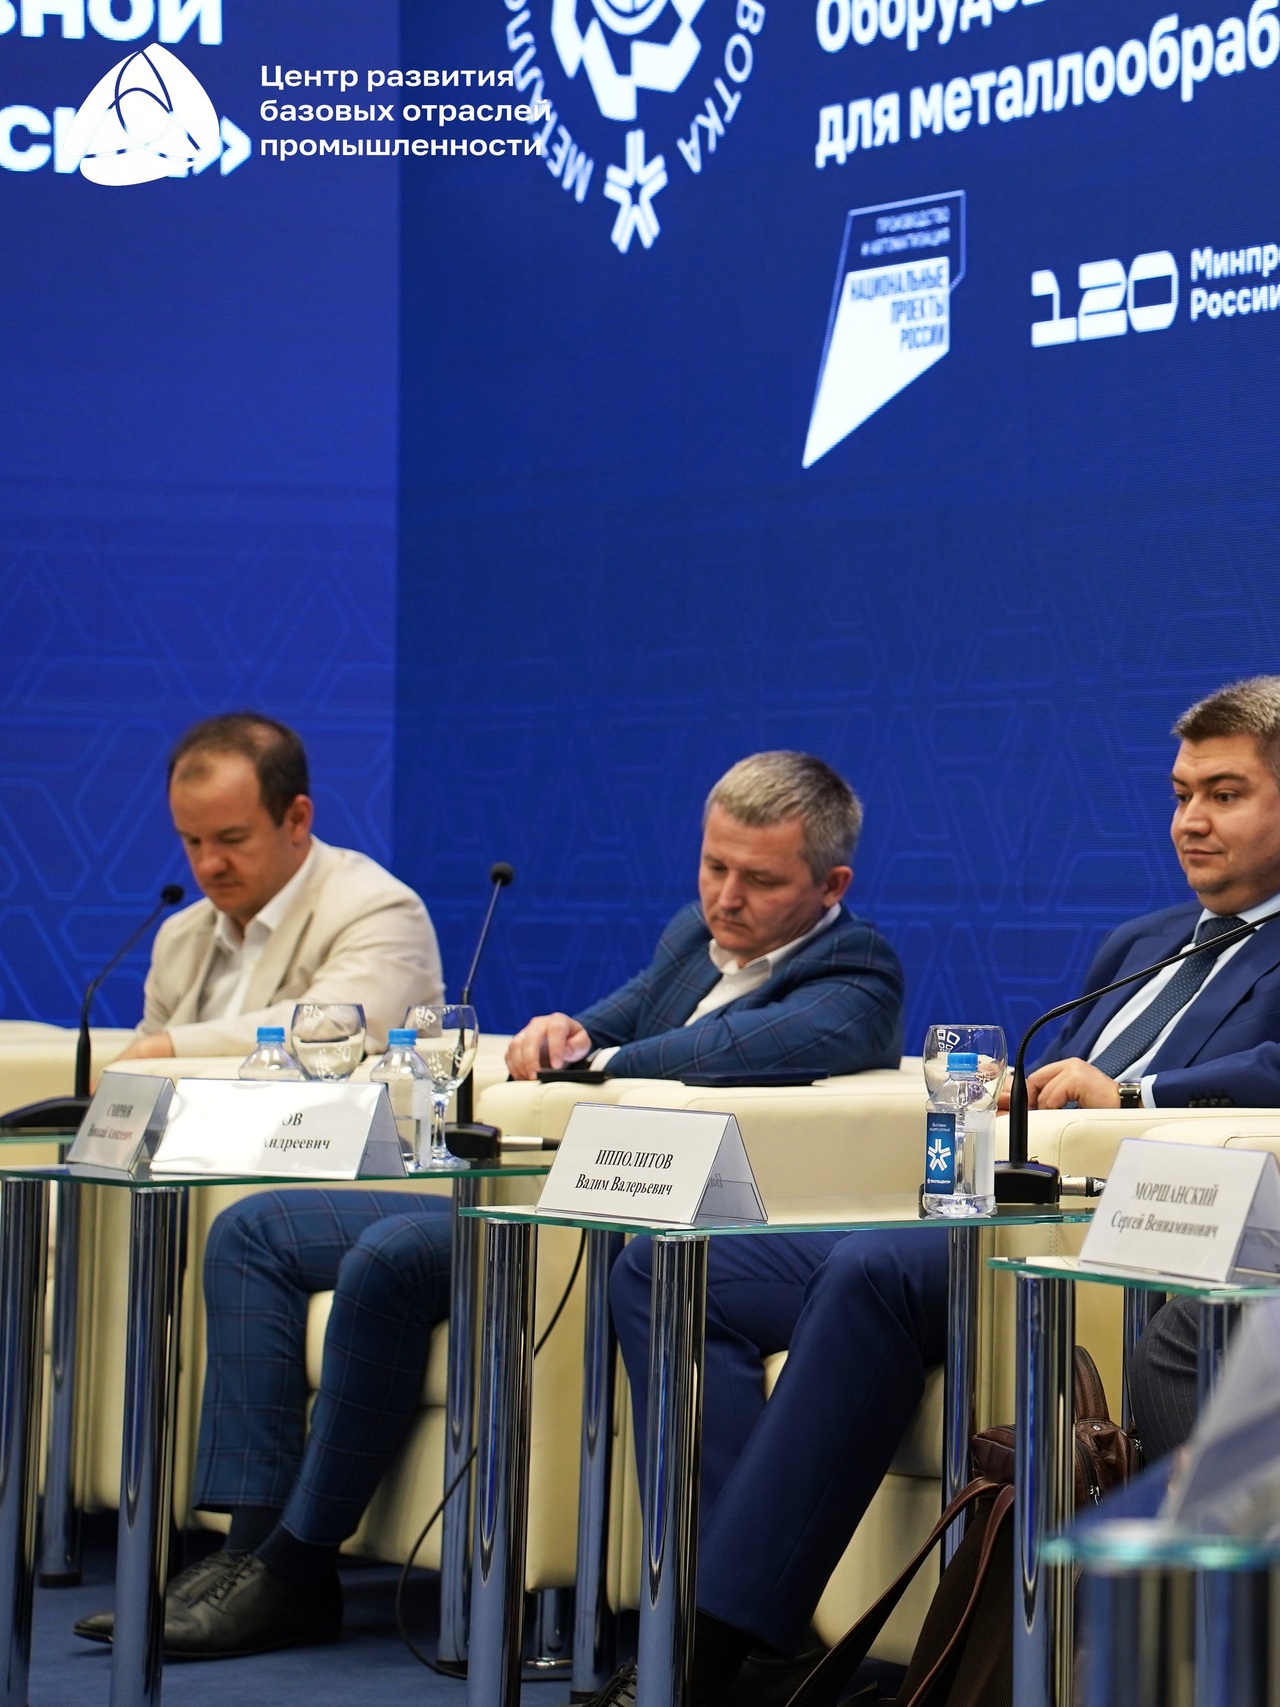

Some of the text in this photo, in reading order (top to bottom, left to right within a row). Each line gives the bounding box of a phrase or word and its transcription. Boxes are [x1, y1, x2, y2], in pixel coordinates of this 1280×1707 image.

[815, 91, 900, 169] для
[1031, 250, 1179, 348] 120
[595, 1149, 674, 1169] ИППОЛИТОВ
[575, 1173, 673, 1197] Вадим Валерьевич
[1134, 1181, 1219, 1207] МОРШАНСКИЙ
[1110, 1210, 1219, 1238] Сергей Вениаминович
